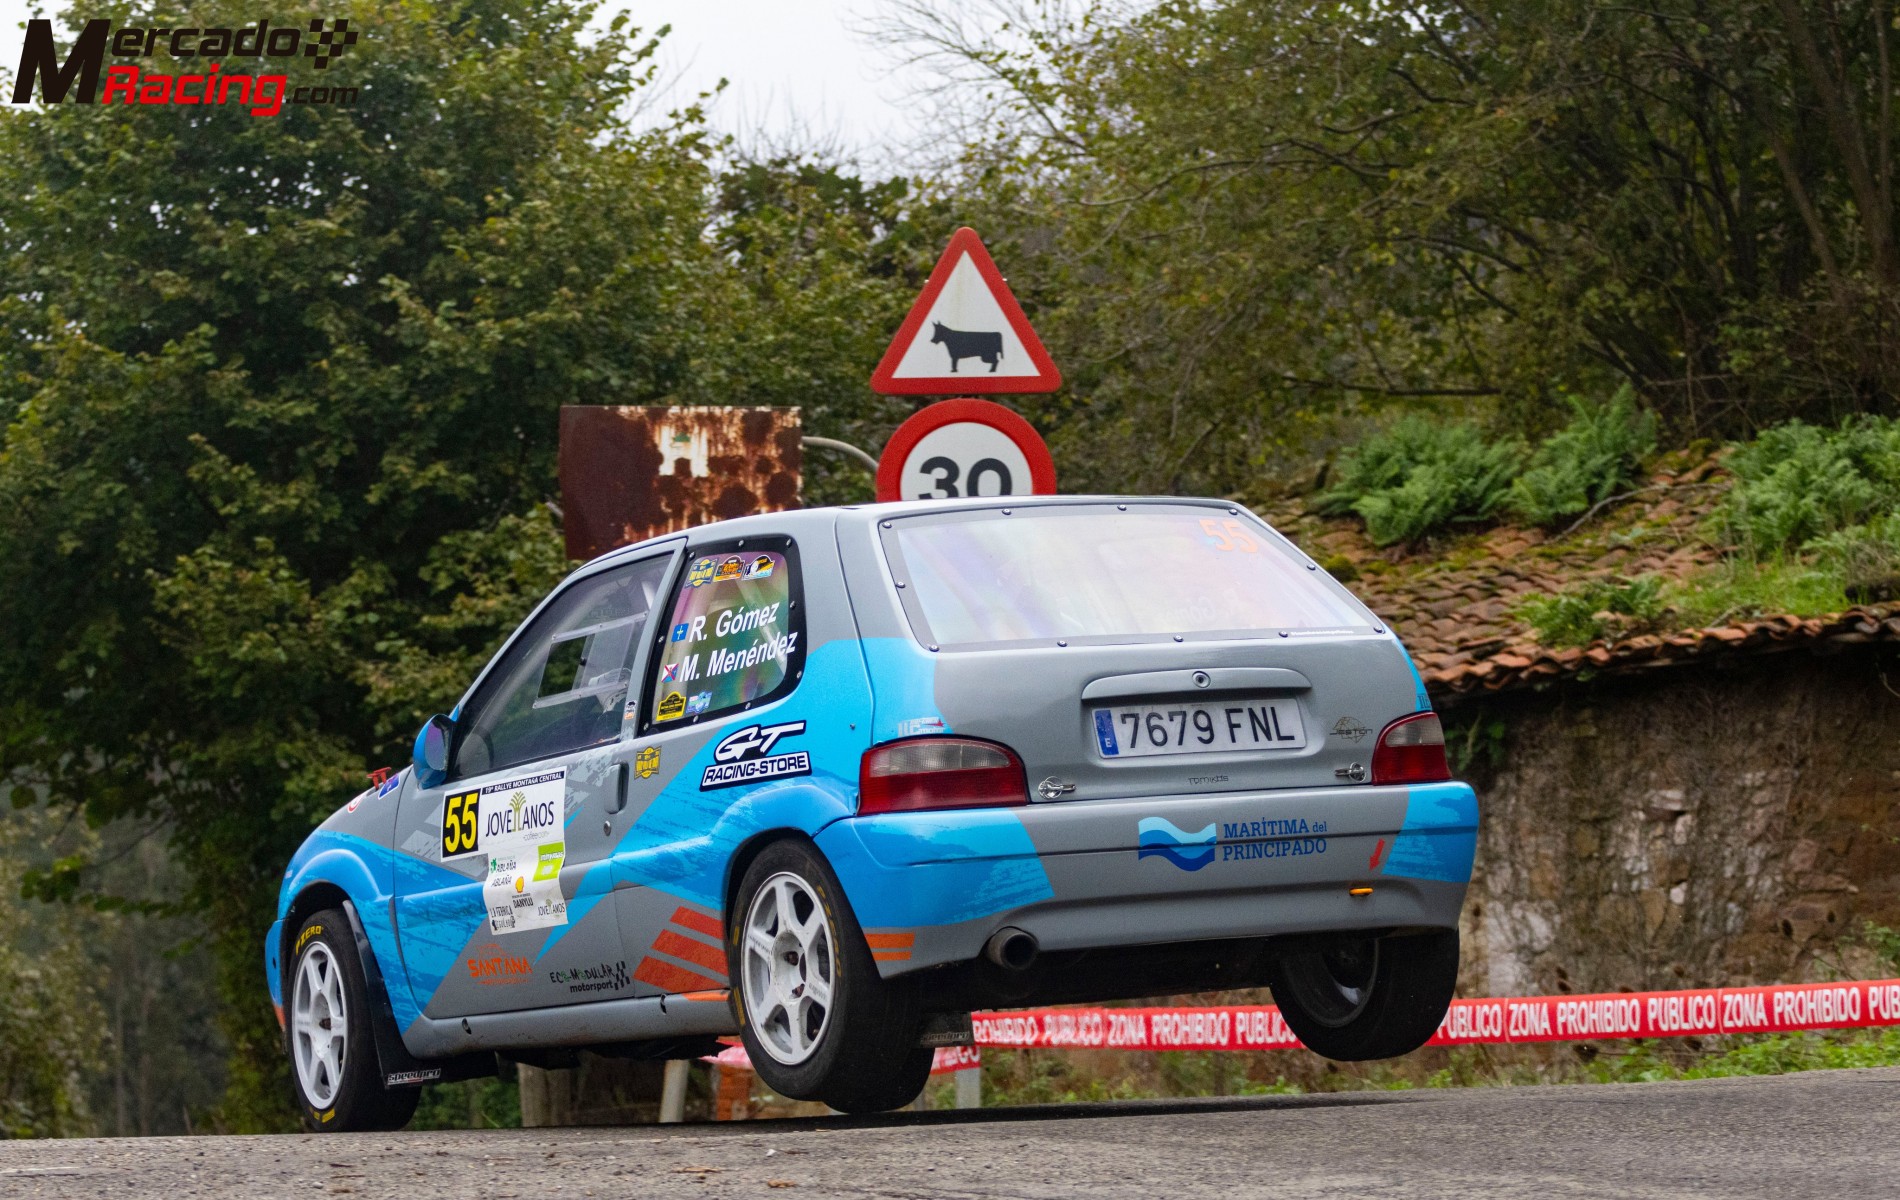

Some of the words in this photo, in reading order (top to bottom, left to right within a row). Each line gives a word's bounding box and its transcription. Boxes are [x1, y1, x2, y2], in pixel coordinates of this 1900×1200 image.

[918, 456, 1013, 499] 30
[1200, 519, 1258, 553] 55
[689, 616, 708, 643] R.
[716, 602, 780, 638] Gómez
[680, 656, 700, 682] M.
[707, 632, 798, 677] Menéndez
[714, 722, 806, 763] GT
[1120, 710, 1215, 749] 7679
[1225, 706, 1295, 743] FNL
[539, 772, 562, 783] CENTRAL
[704, 755, 807, 784] RACING-STORE
[445, 792, 479, 853] 55
[1223, 817, 1309, 838] MARÍTIMA
[1312, 821, 1327, 833] del
[1223, 838, 1327, 861] PRINCIPADO
[301, 925, 322, 946] ZERO
[467, 957, 533, 978] SANTANA
[569, 981, 614, 994] motorsport
[972, 1017, 1039, 1045] ROHIBIDO
[1043, 1012, 1103, 1046] PUBLICO
[1108, 1014, 1148, 1046] ZONA
[1152, 1011, 1230, 1046] PROHIBIDO
[1509, 1003, 1552, 1037] ZONA
[1556, 998, 1640, 1035] PROHIBIDO
[1648, 994, 1716, 1031] PUBLICO
[1723, 992, 1769, 1028] ZONA
[1773, 986, 1861, 1026] PROHIBIDO
